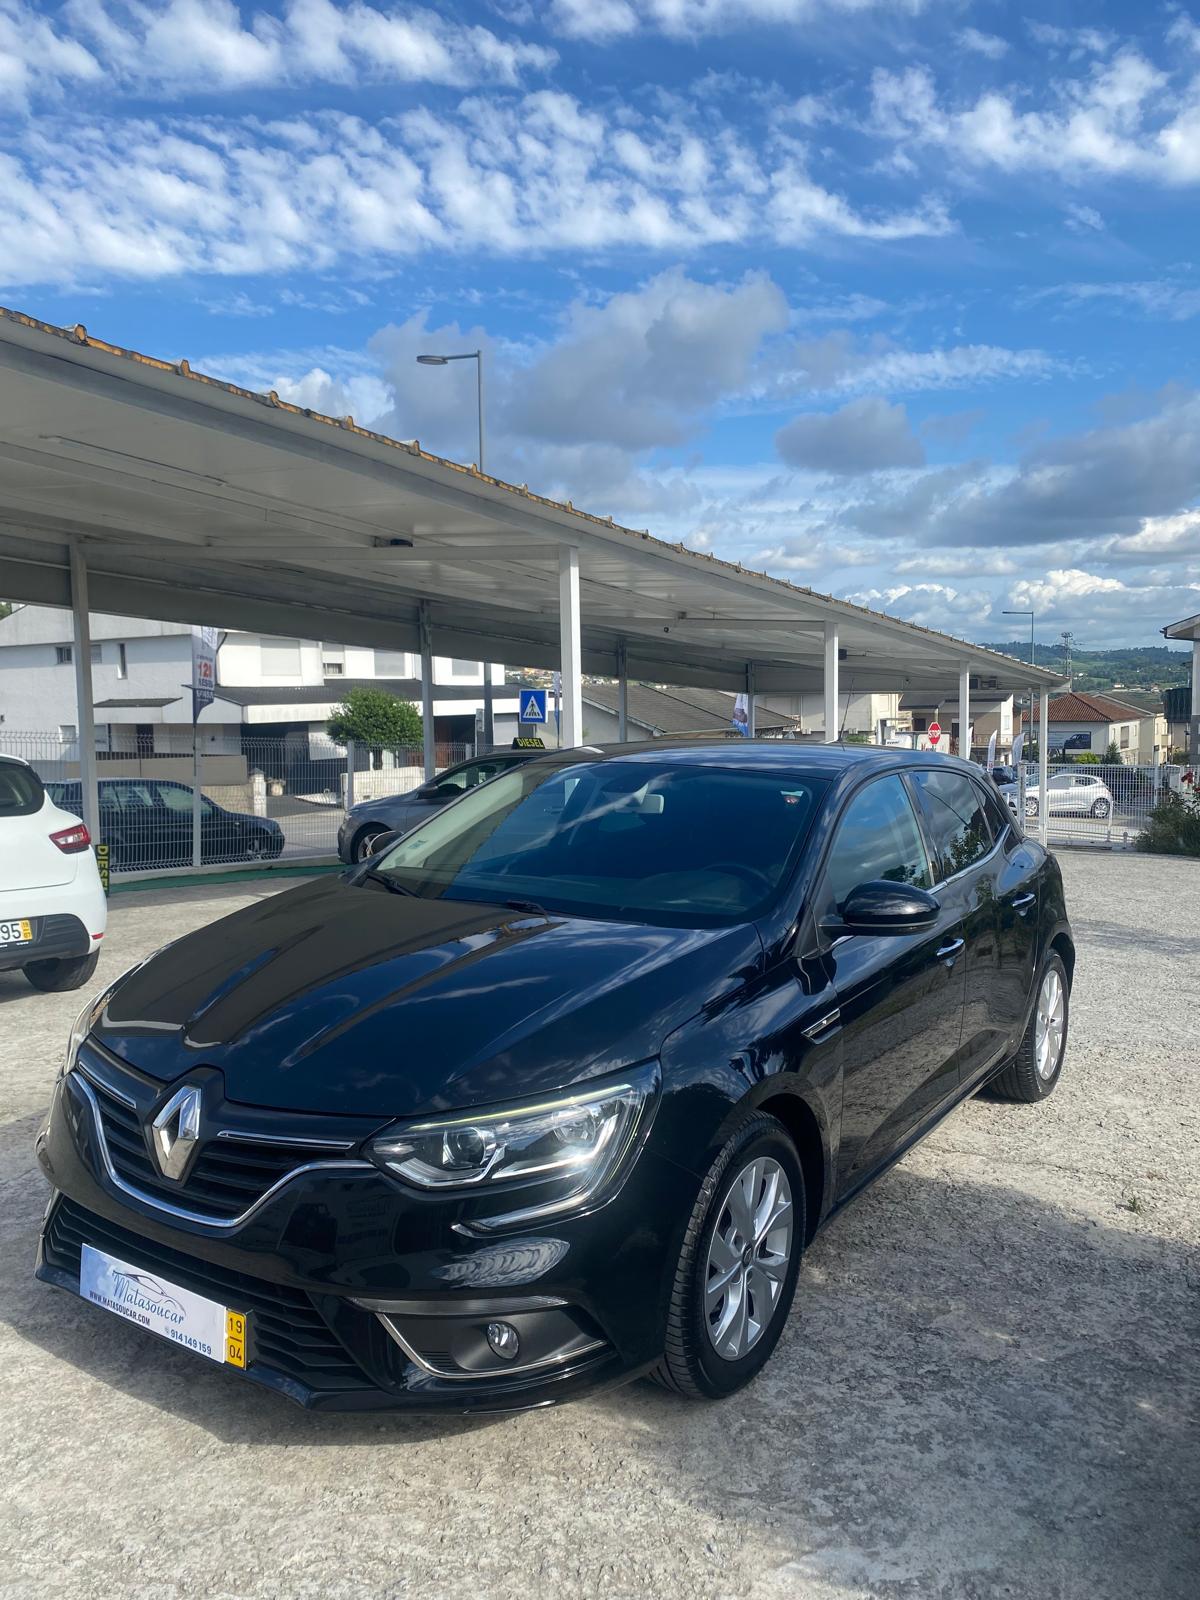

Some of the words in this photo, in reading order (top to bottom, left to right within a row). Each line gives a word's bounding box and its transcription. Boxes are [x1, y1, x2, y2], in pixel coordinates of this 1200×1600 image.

[928, 729, 940, 738] STOP
[516, 738, 544, 748] DIESEL
[0, 923, 21, 940] 95
[113, 1272, 184, 1325] Matasoucar
[90, 1290, 151, 1327] WWW.MATASOUCAR.COM
[229, 1317, 242, 1333] 19
[170, 1329, 183, 1342] 914
[184, 1335, 198, 1349] 149
[198, 1341, 212, 1355] 159
[229, 1345, 242, 1361] 04
